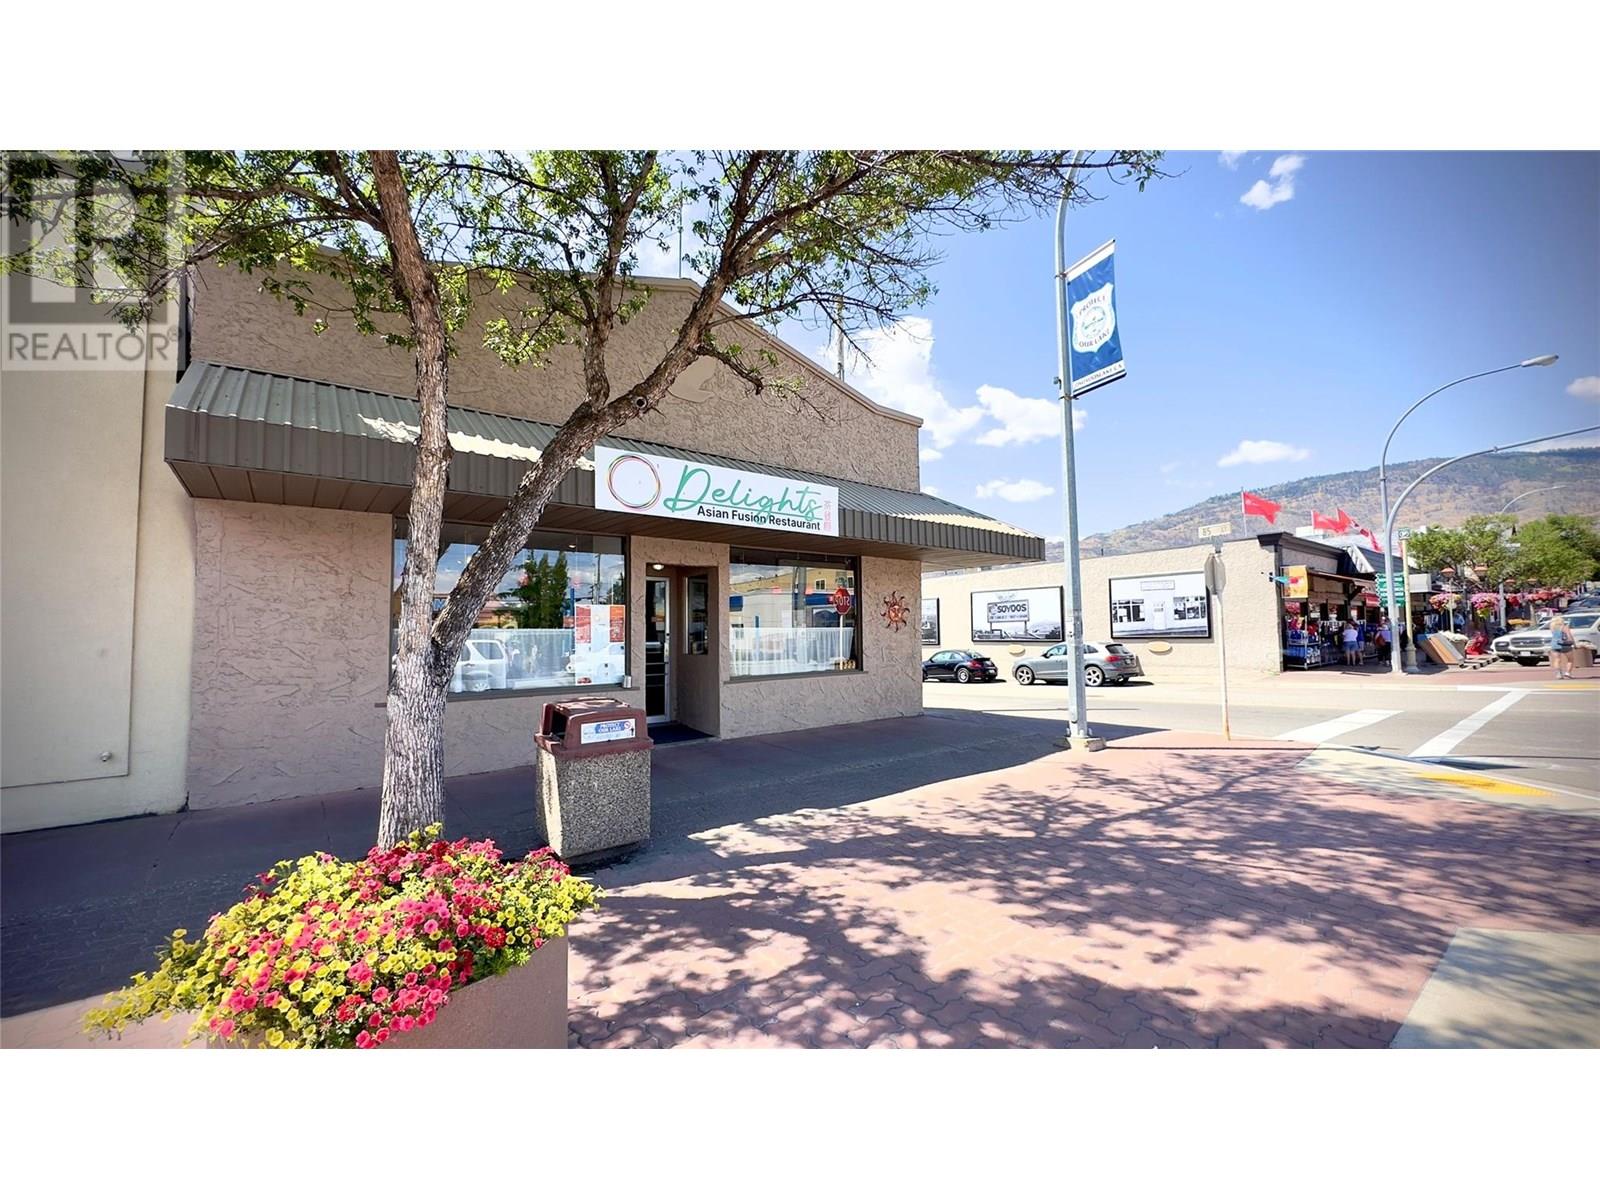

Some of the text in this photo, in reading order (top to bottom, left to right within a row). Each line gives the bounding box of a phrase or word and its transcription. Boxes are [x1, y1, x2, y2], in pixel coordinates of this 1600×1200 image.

[697, 505, 730, 520] Asian
[731, 508, 767, 523] Fusion
[768, 514, 821, 531] Restaurant
